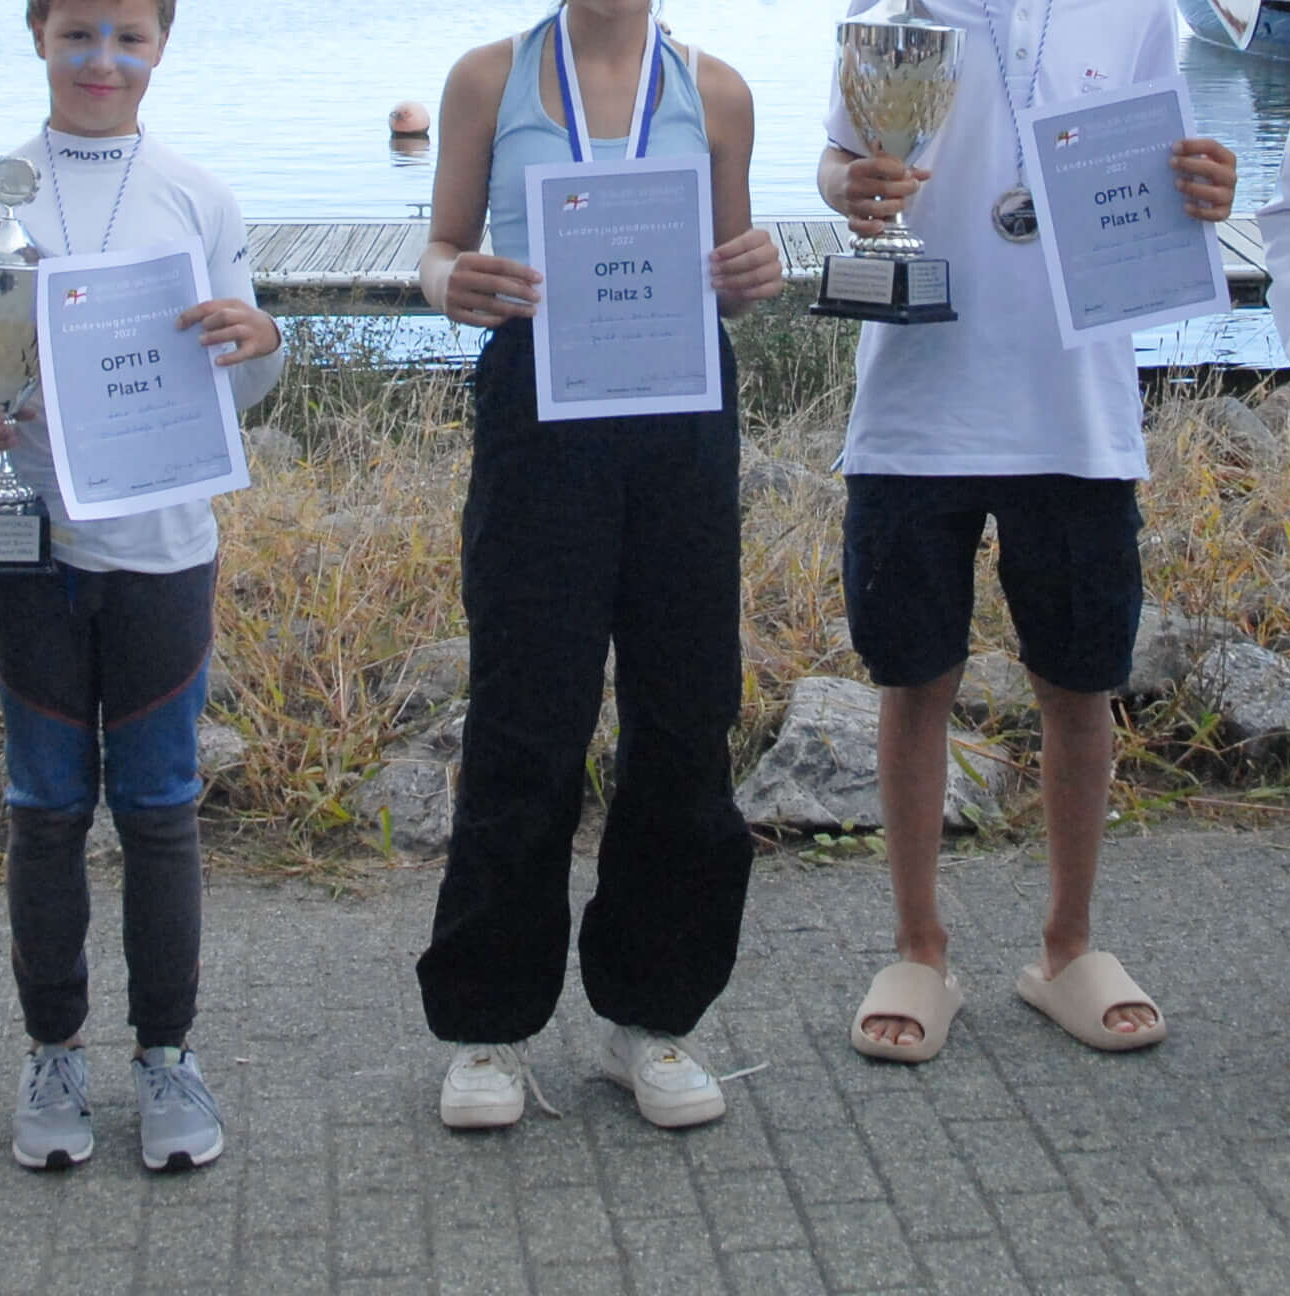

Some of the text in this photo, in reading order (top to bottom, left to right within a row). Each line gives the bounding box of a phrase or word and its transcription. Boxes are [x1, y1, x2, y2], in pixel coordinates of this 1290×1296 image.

[58, 147, 123, 161] MUSTO
[1094, 182, 1150, 205] OPTI A
[1100, 207, 1151, 230] Platz 1
[594, 259, 653, 277] OPTI A
[597, 285, 653, 303] Platz 3
[101, 349, 161, 372] OPTI B
[107, 376, 163, 398] Platz 1
